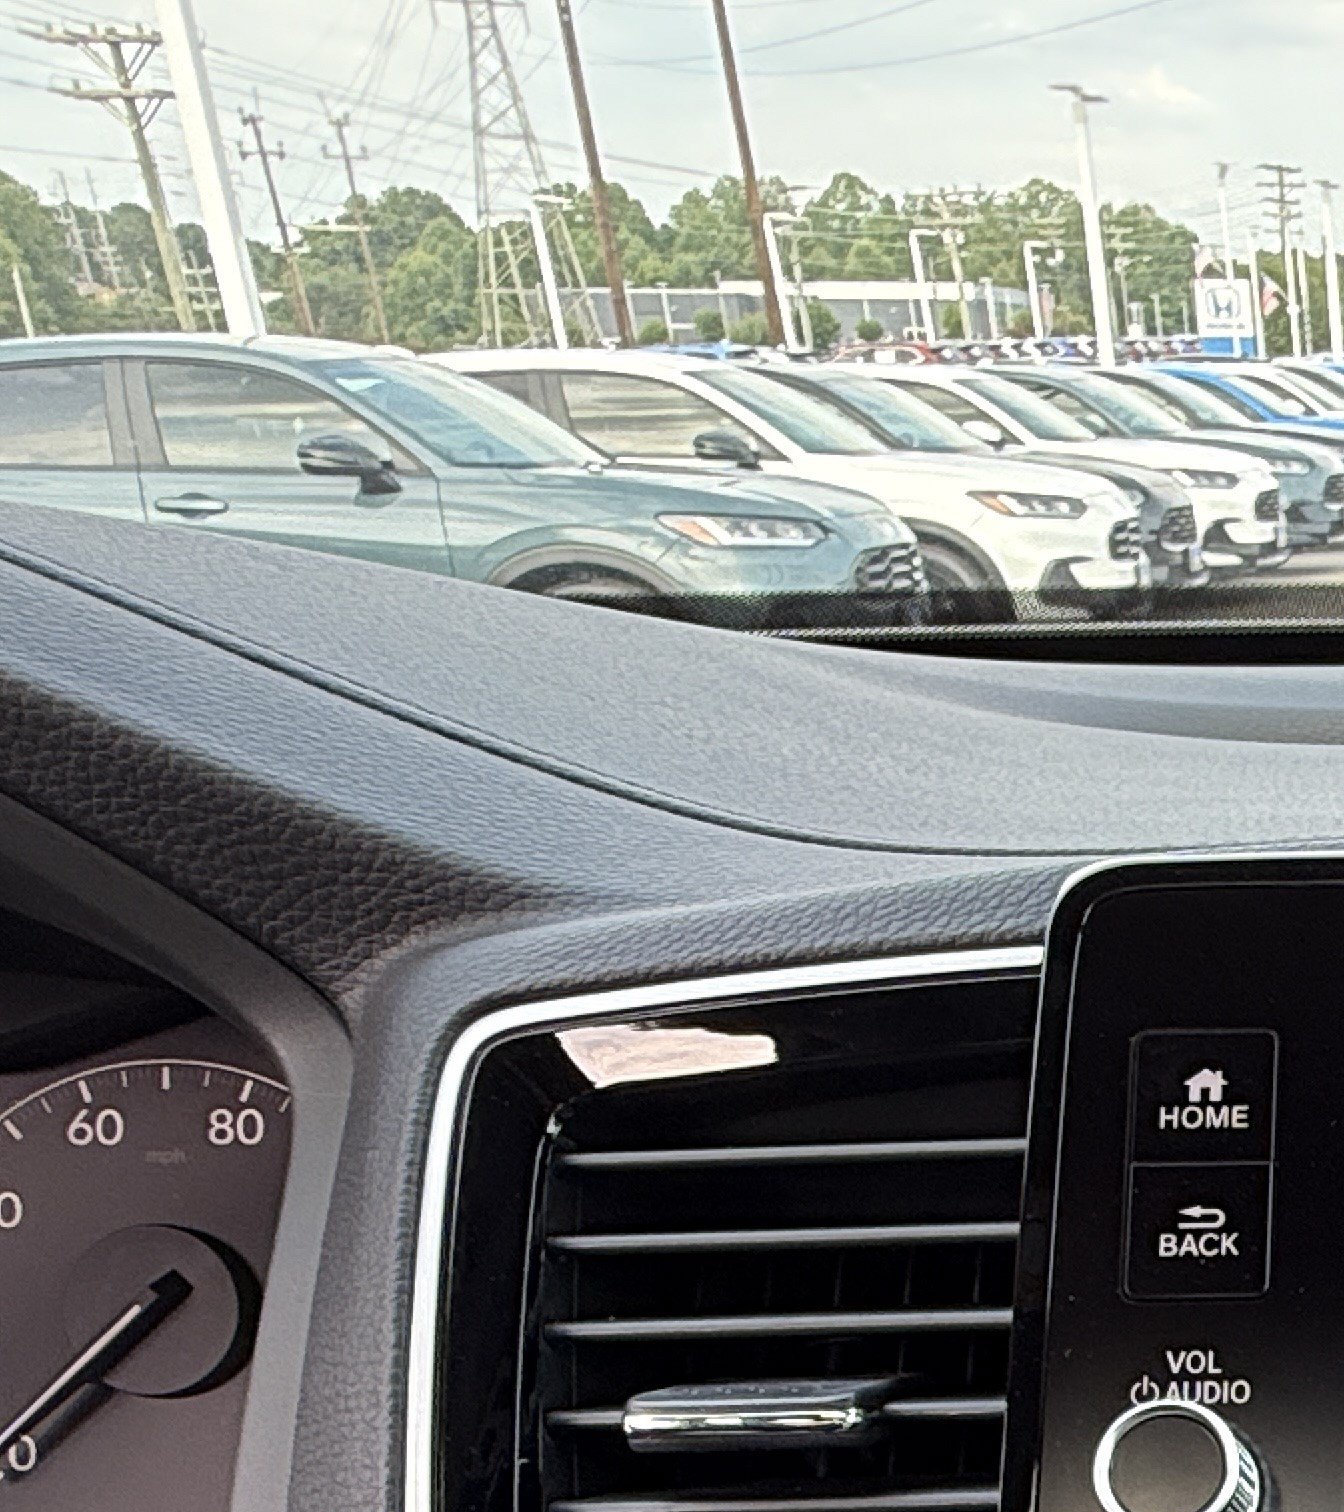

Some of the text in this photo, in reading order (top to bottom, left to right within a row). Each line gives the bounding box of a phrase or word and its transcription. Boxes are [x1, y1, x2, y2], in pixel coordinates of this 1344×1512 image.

[67, 1109, 123, 1145] 60
[209, 1109, 264, 1145] 80
[1160, 1105, 1249, 1129] HOME
[145, 1147, 187, 1166] mph
[1159, 1233, 1239, 1257] BACK
[1167, 1351, 1221, 1373] VOL
[1165, 1380, 1251, 1404] AUDIO
[8, 1436, 36, 1471] 0
